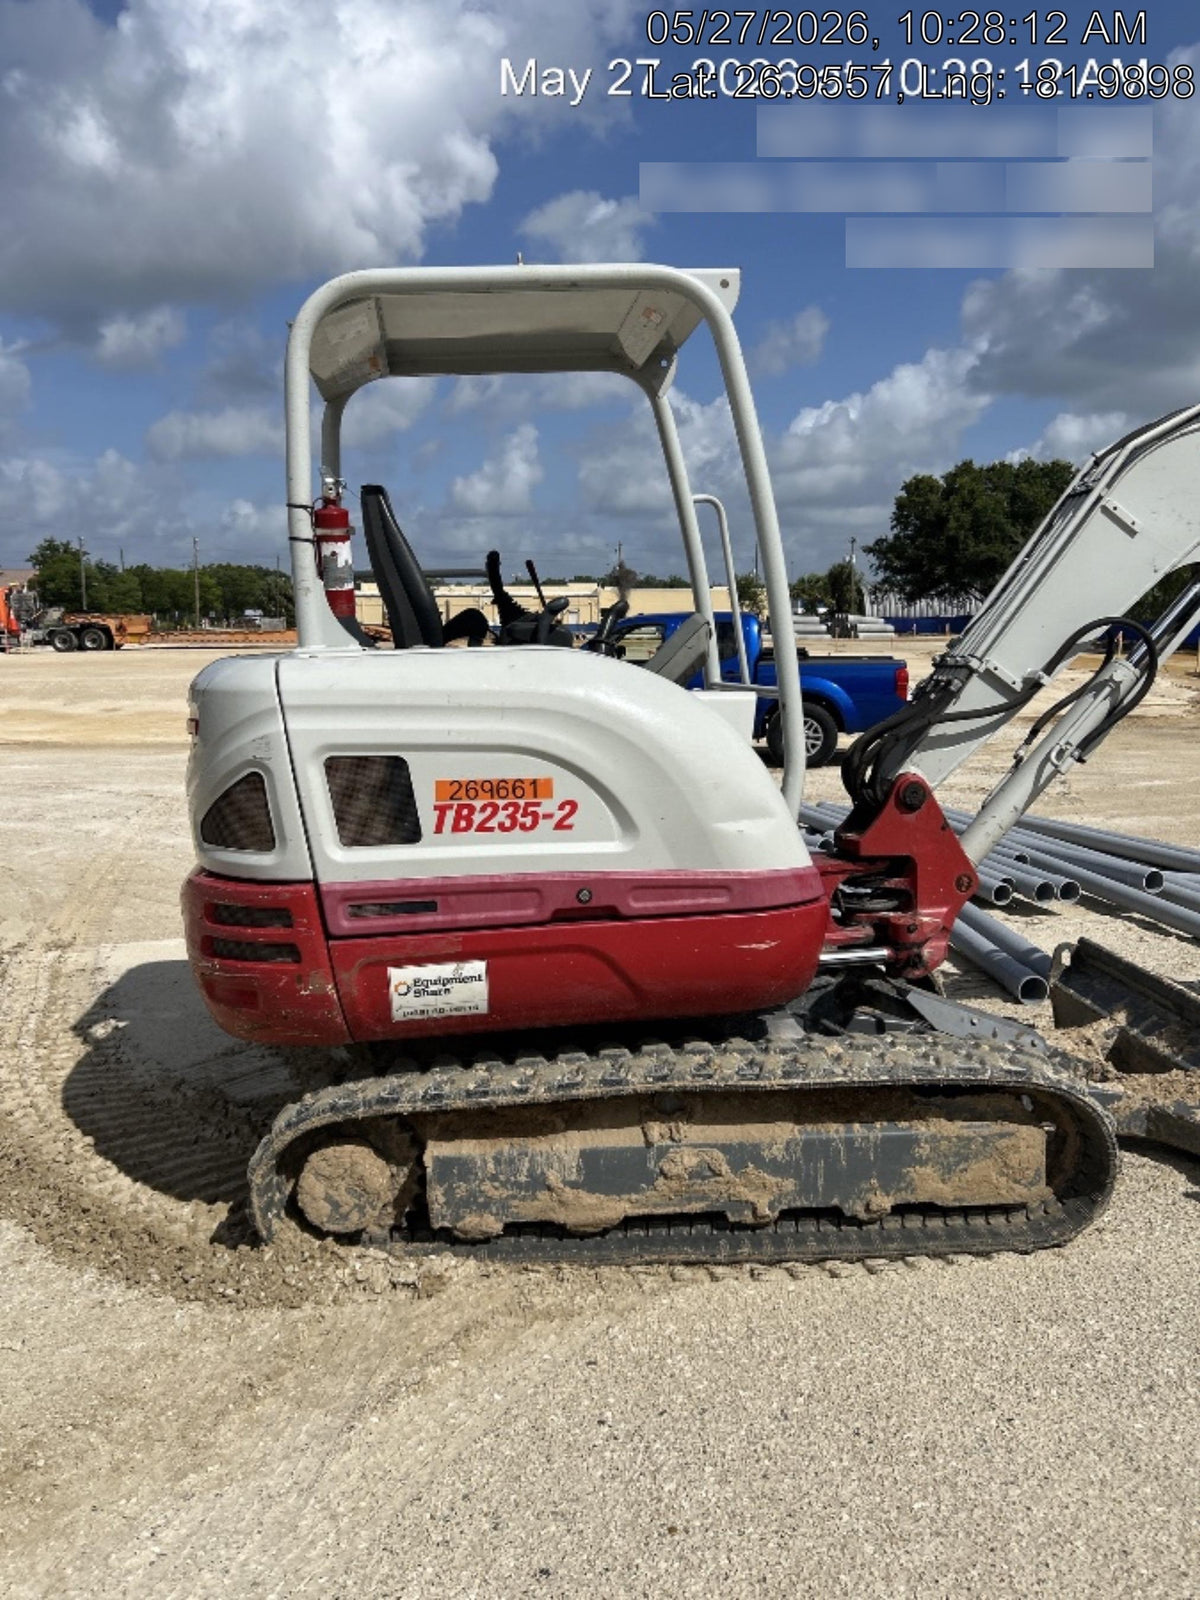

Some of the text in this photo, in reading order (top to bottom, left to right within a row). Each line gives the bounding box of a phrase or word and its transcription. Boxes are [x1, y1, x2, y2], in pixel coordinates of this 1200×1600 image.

[449, 778, 538, 801] 269661
[433, 799, 579, 834] TB235-2
[413, 973, 484, 989] Equipment
